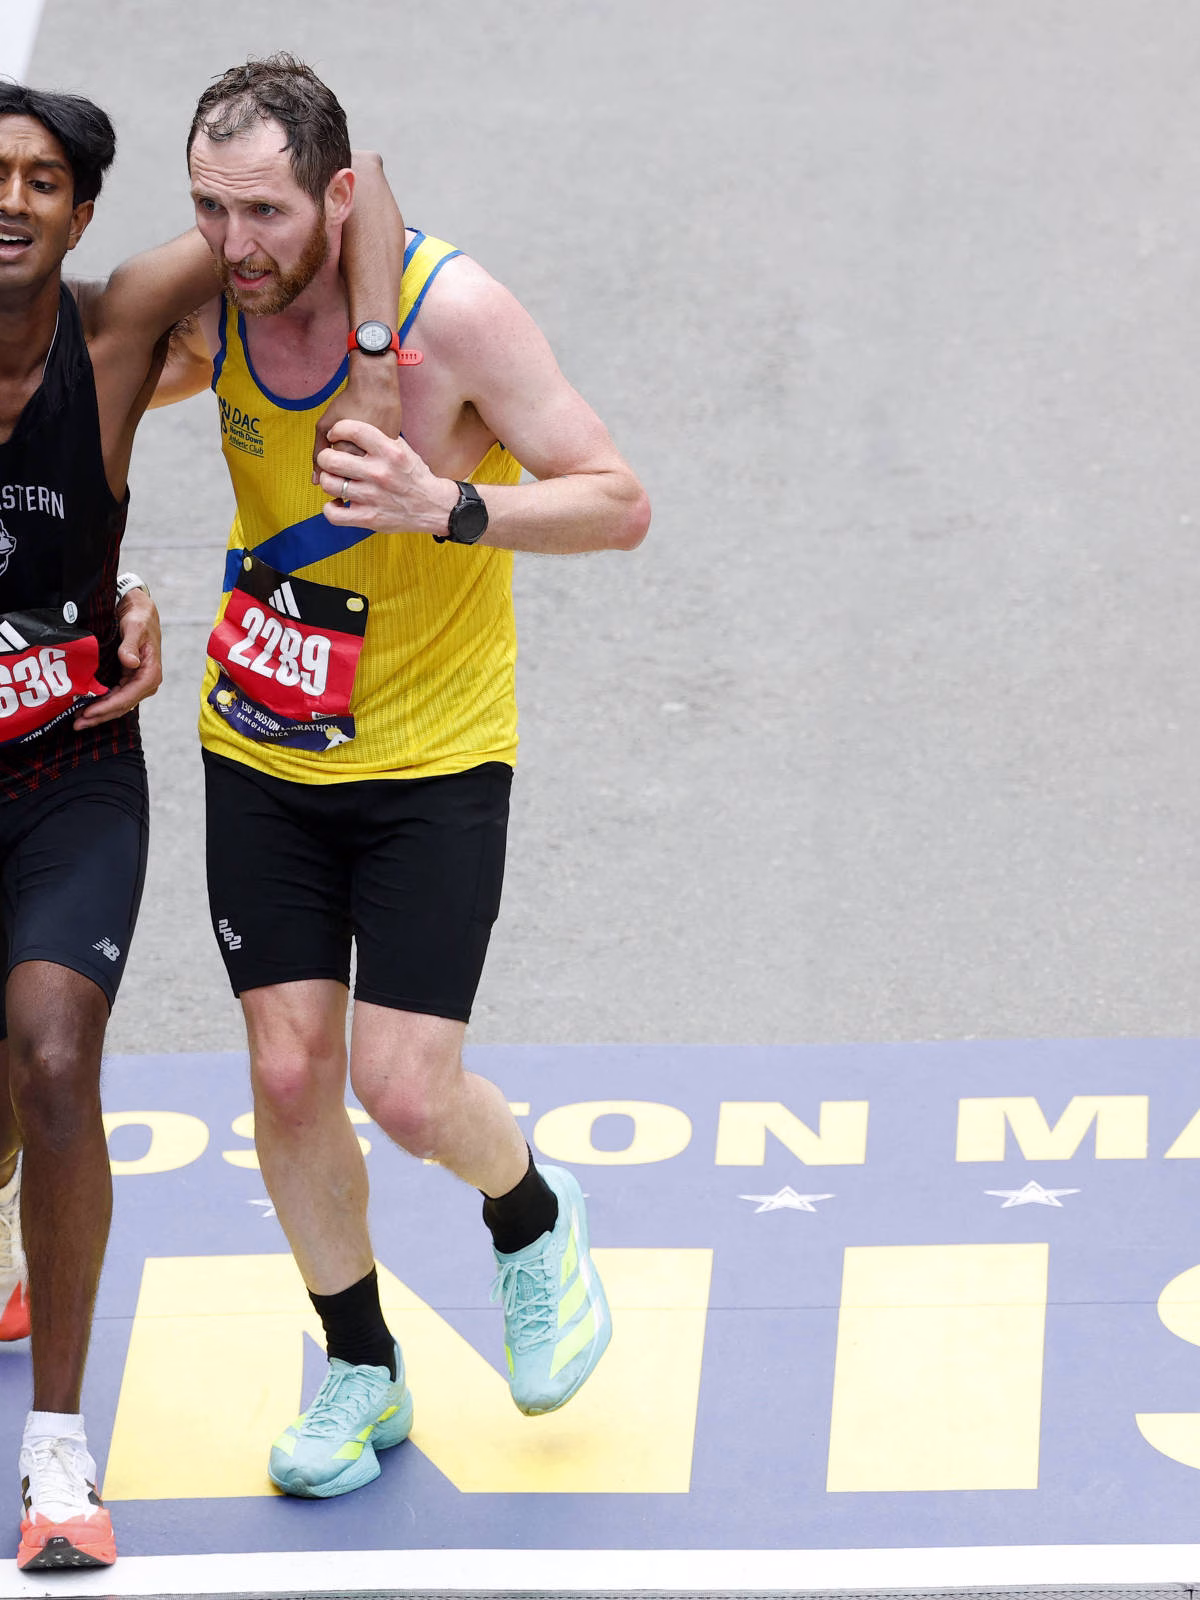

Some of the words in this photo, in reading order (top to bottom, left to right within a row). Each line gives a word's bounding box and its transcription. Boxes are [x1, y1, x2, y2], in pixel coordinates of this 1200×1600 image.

[228, 607, 332, 696] 2289
[236, 712, 252, 726] BANK
[250, 721, 258, 729] OF
[256, 726, 289, 737] AMERICA
[254, 711, 281, 731] BOSTON
